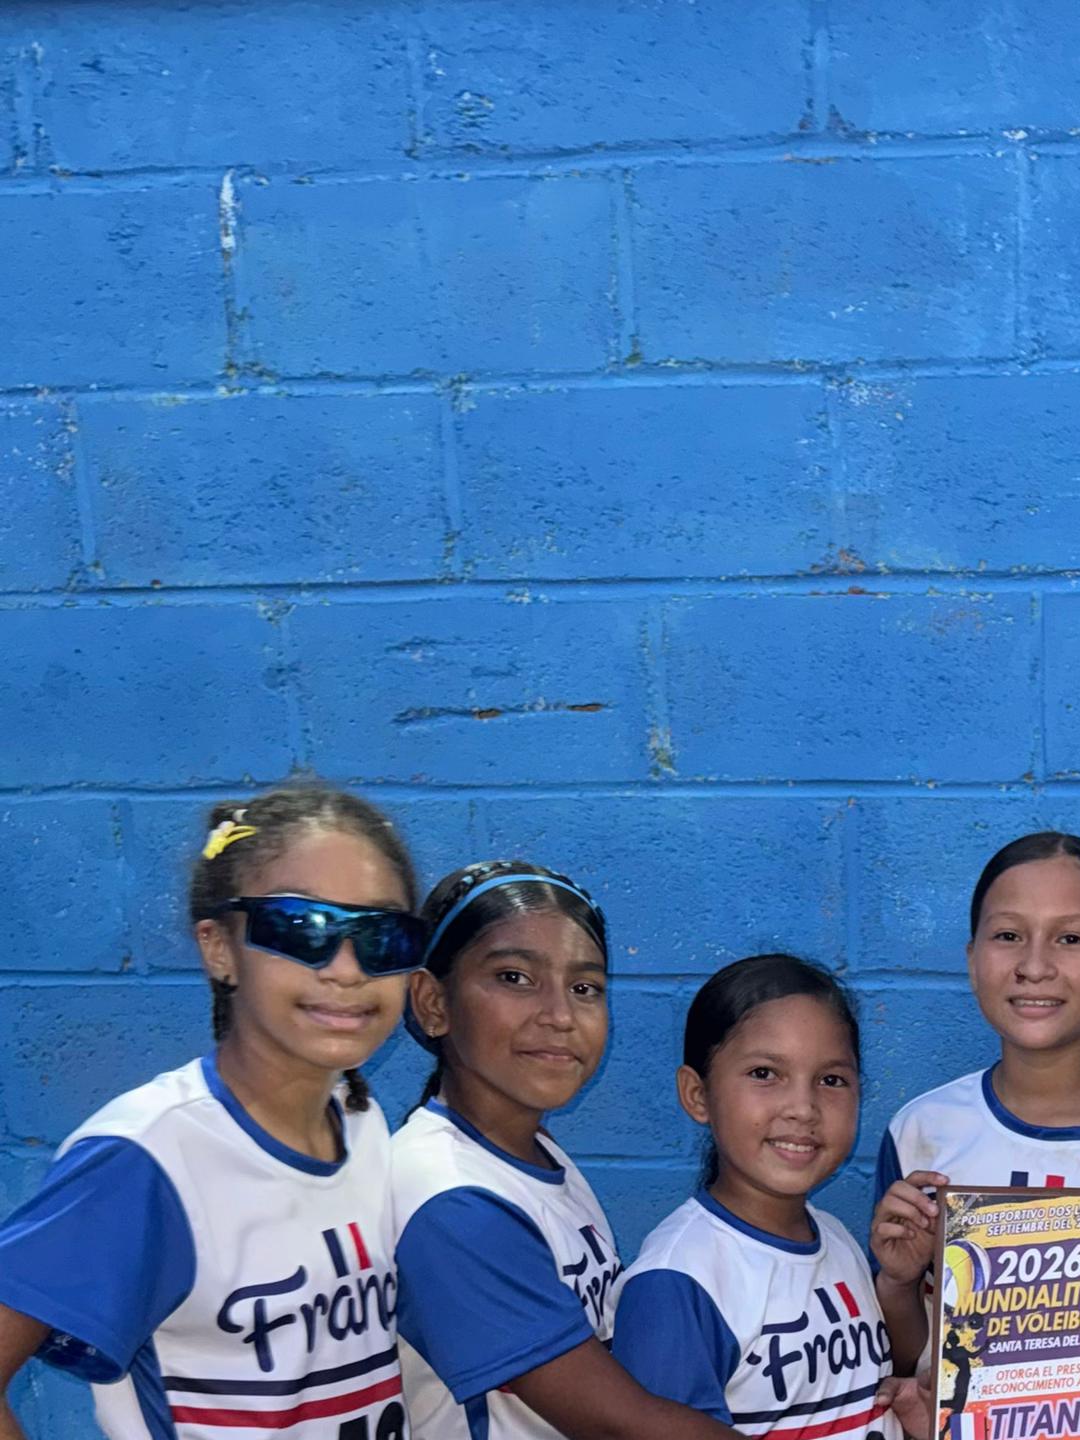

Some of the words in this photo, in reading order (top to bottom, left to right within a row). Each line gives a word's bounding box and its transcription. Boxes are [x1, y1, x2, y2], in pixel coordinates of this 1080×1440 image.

[961, 1206, 1045, 1226] POLIDEPORTIVO
[1048, 1205, 1072, 1217] DOS
[987, 1220, 1050, 1237] SEPTIEMBRE
[1053, 1218, 1072, 1230] DEL
[987, 1316, 1011, 1337] DE
[988, 1340, 1022, 1354] SANTA
[1024, 1335, 1061, 1350] TERESA
[1062, 1333, 1080, 1347] DEL
[995, 1366, 1040, 1382] OTORGA
[1042, 1365, 1054, 1377] EL
[980, 1377, 1074, 1396] RECONOCIMIENTO
